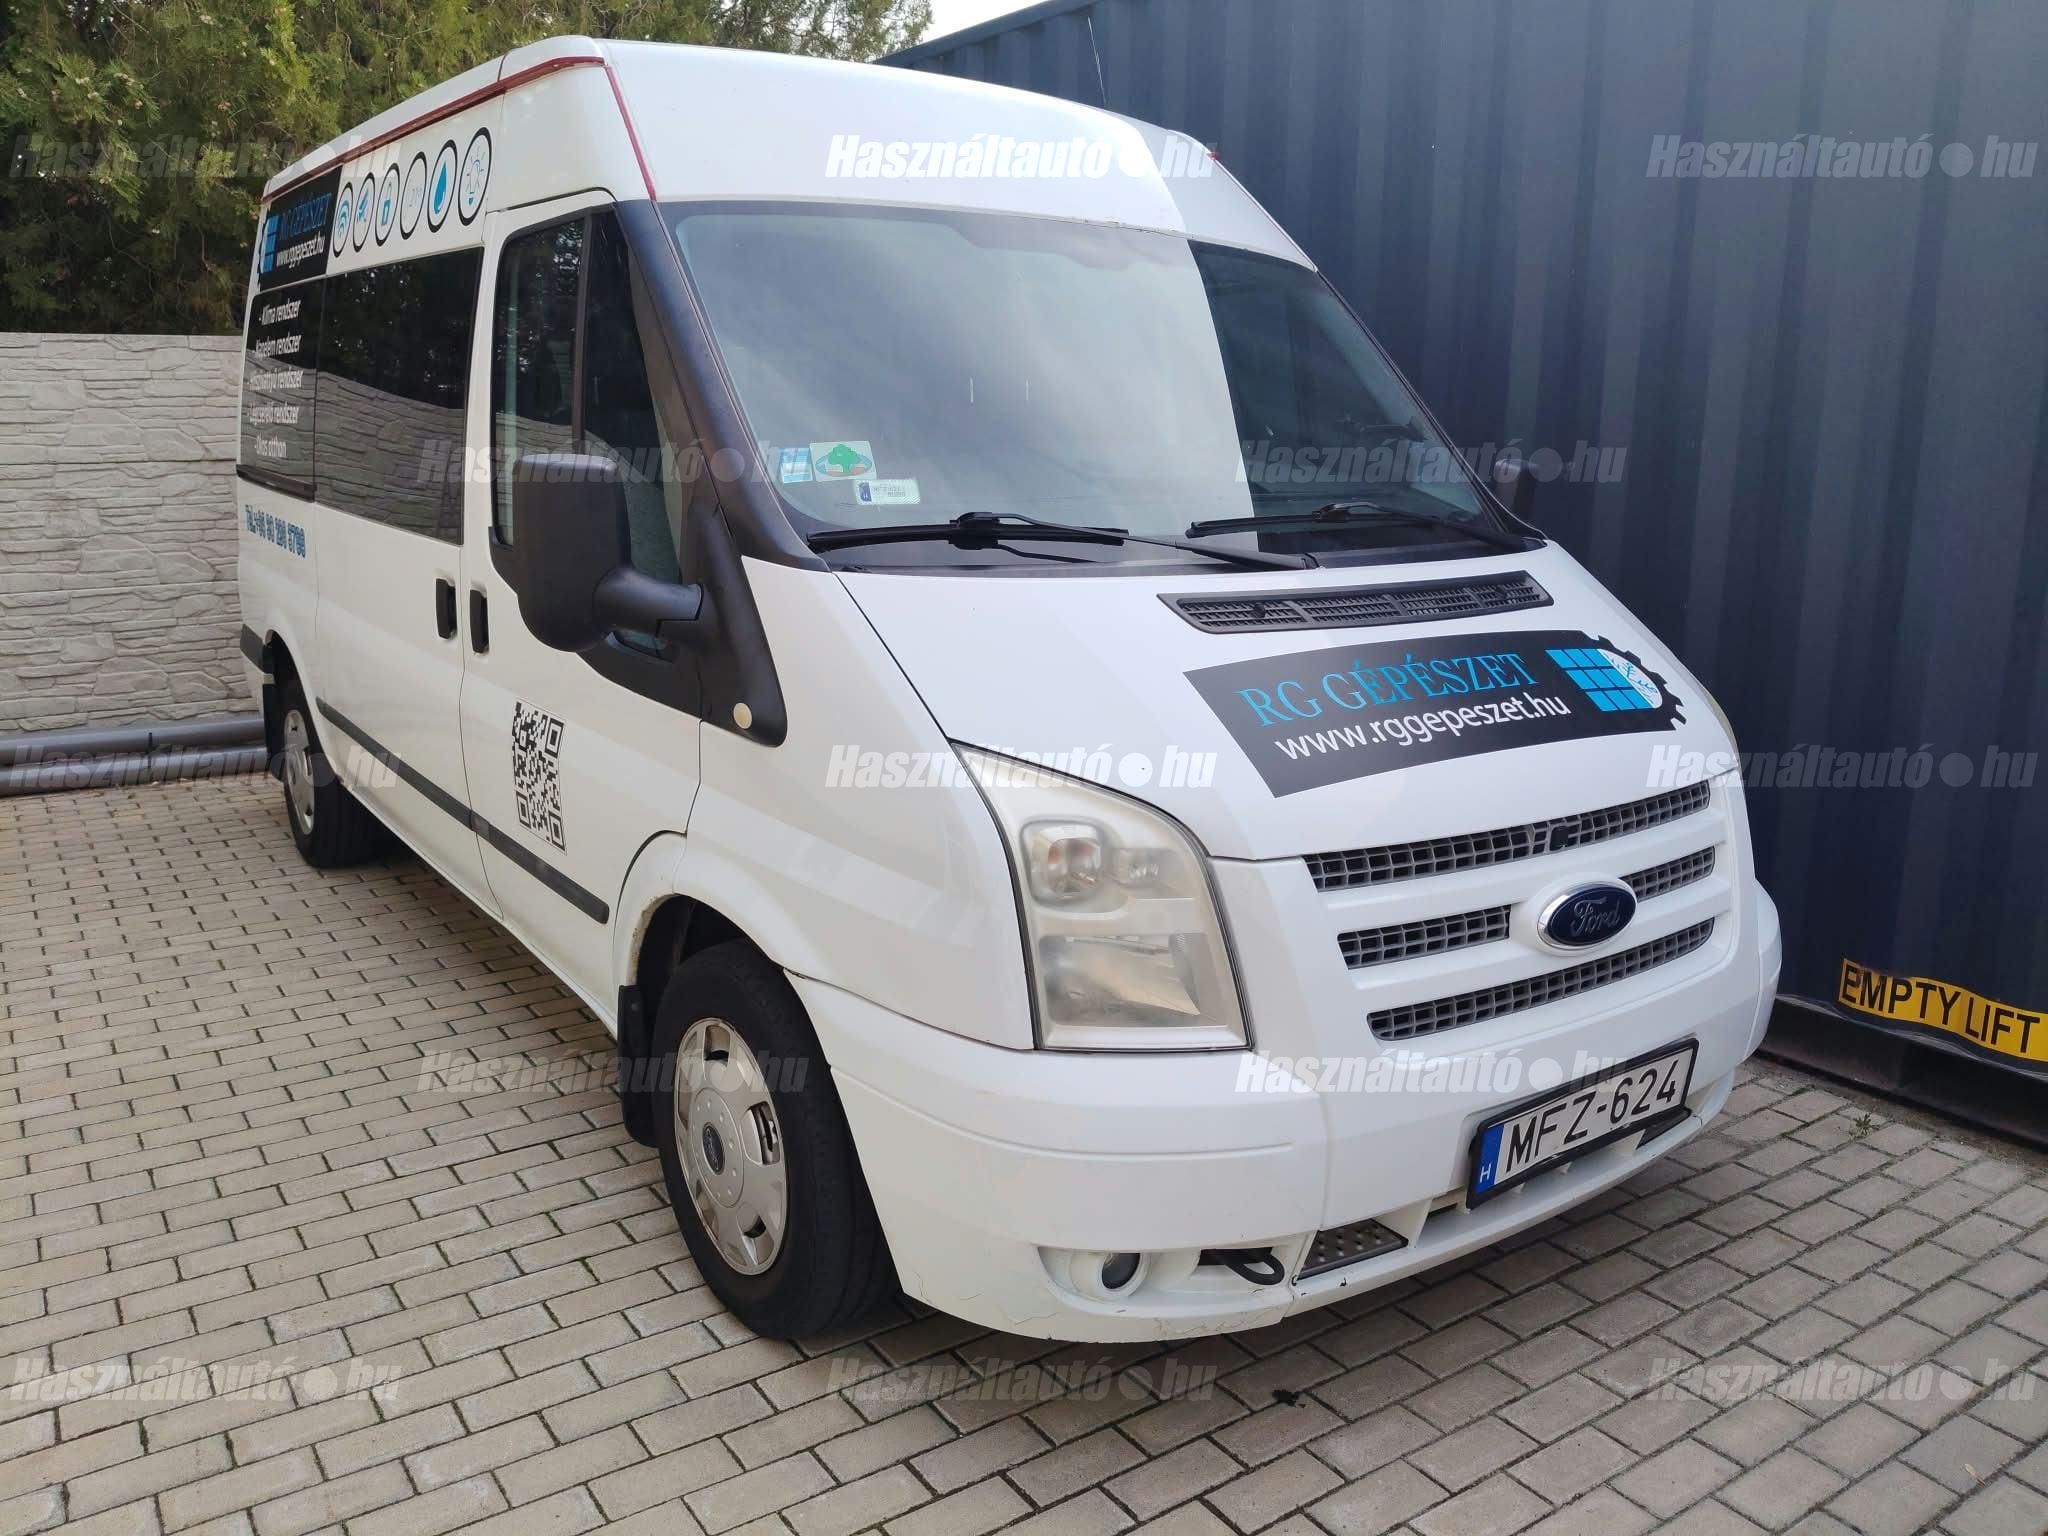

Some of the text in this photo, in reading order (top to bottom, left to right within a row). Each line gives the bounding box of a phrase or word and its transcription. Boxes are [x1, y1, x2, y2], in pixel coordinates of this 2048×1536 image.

[1239, 652, 1540, 728] RG GÉPÉSZET
[1273, 692, 1572, 760] www.rggepeszet.hu
[1569, 893, 1623, 938] Ford
[1840, 964, 2041, 1055] EMPTY LIFT
[1478, 1058, 1679, 1184] H MFZ-624
